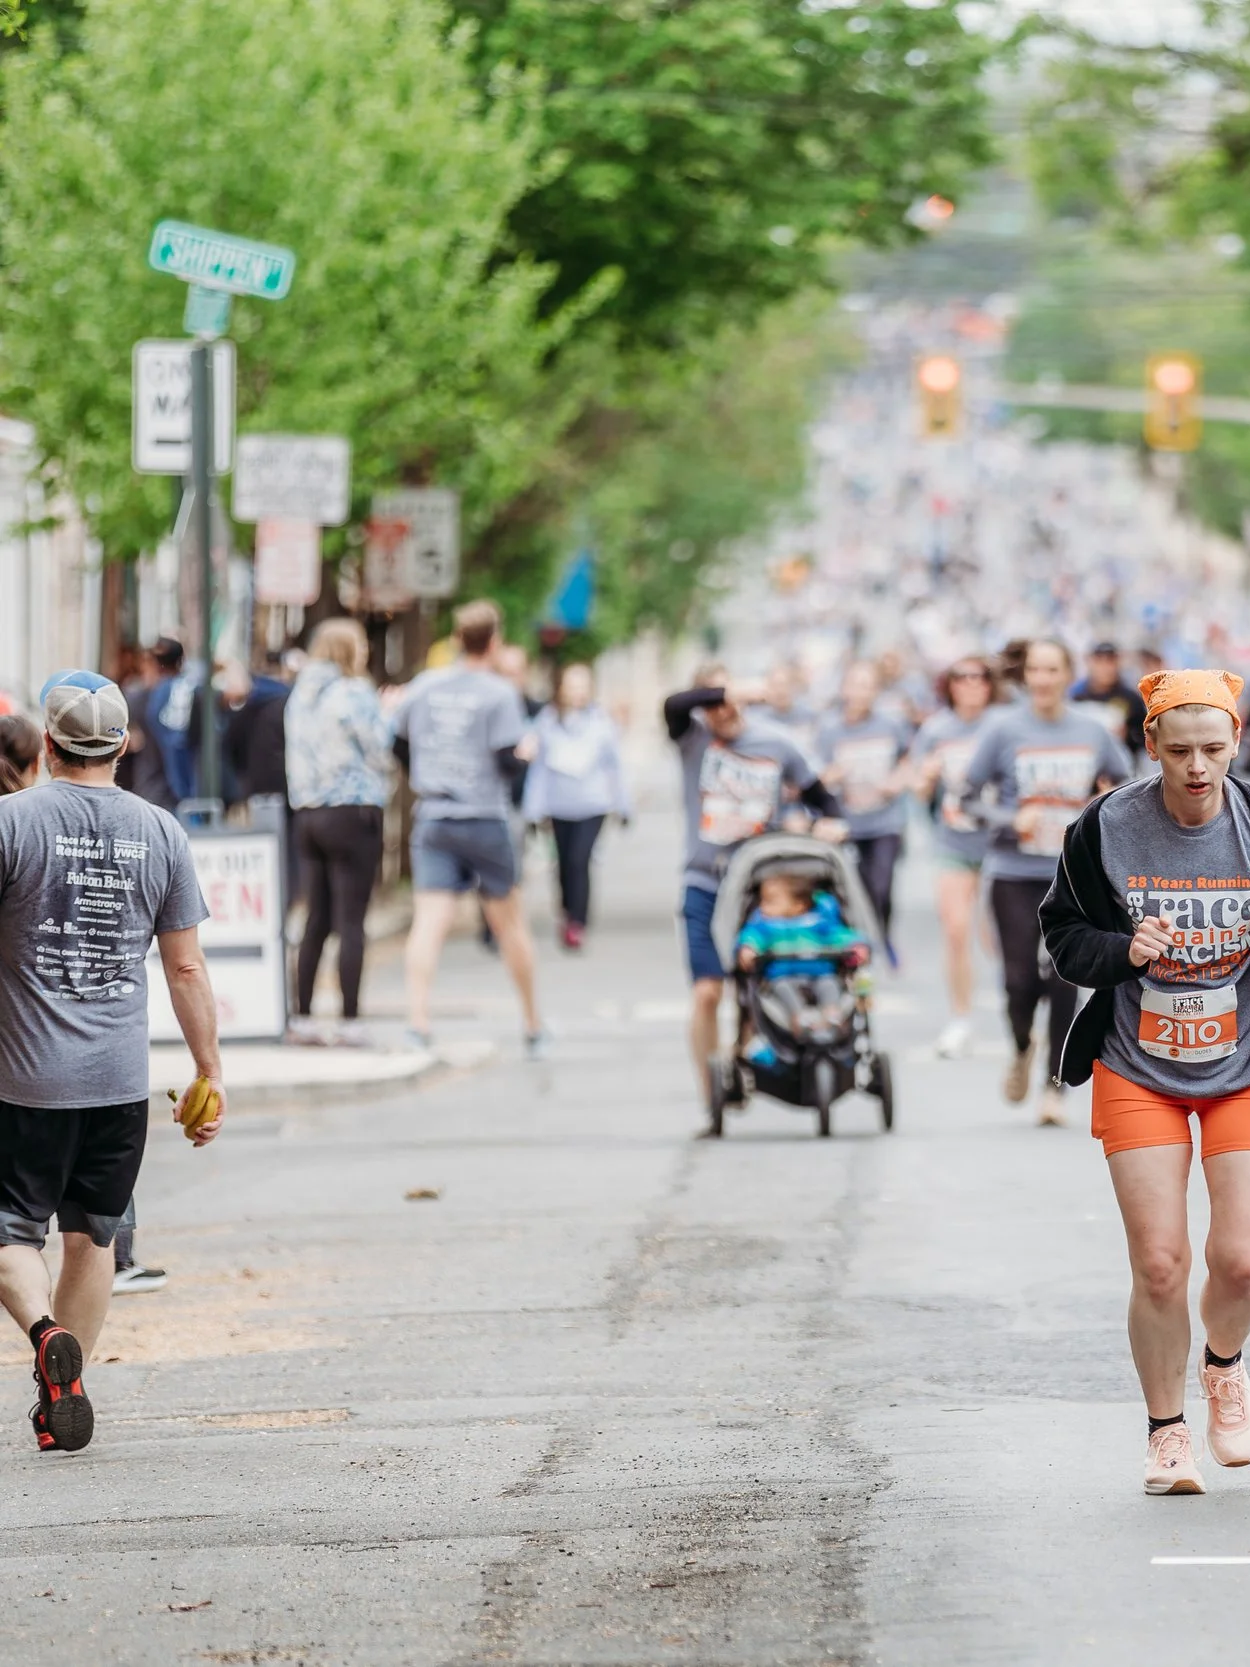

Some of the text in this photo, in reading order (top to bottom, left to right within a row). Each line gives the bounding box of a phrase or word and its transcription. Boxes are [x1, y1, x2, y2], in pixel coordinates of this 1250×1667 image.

[145, 359, 191, 388] ON
[55, 834, 79, 845] Race
[80, 837, 95, 847] For
[96, 838, 105, 848] A
[55, 844, 105, 860] Reason!
[113, 846, 146, 860] ywca
[66, 871, 102, 888] Fulton
[103, 874, 136, 891] Bank
[1127, 875, 1148, 889] 28
[1151, 875, 1193, 889] Years
[74, 896, 123, 911] Armstrong
[208, 882, 265, 922] EN
[1156, 1018, 1222, 1045] 2110
